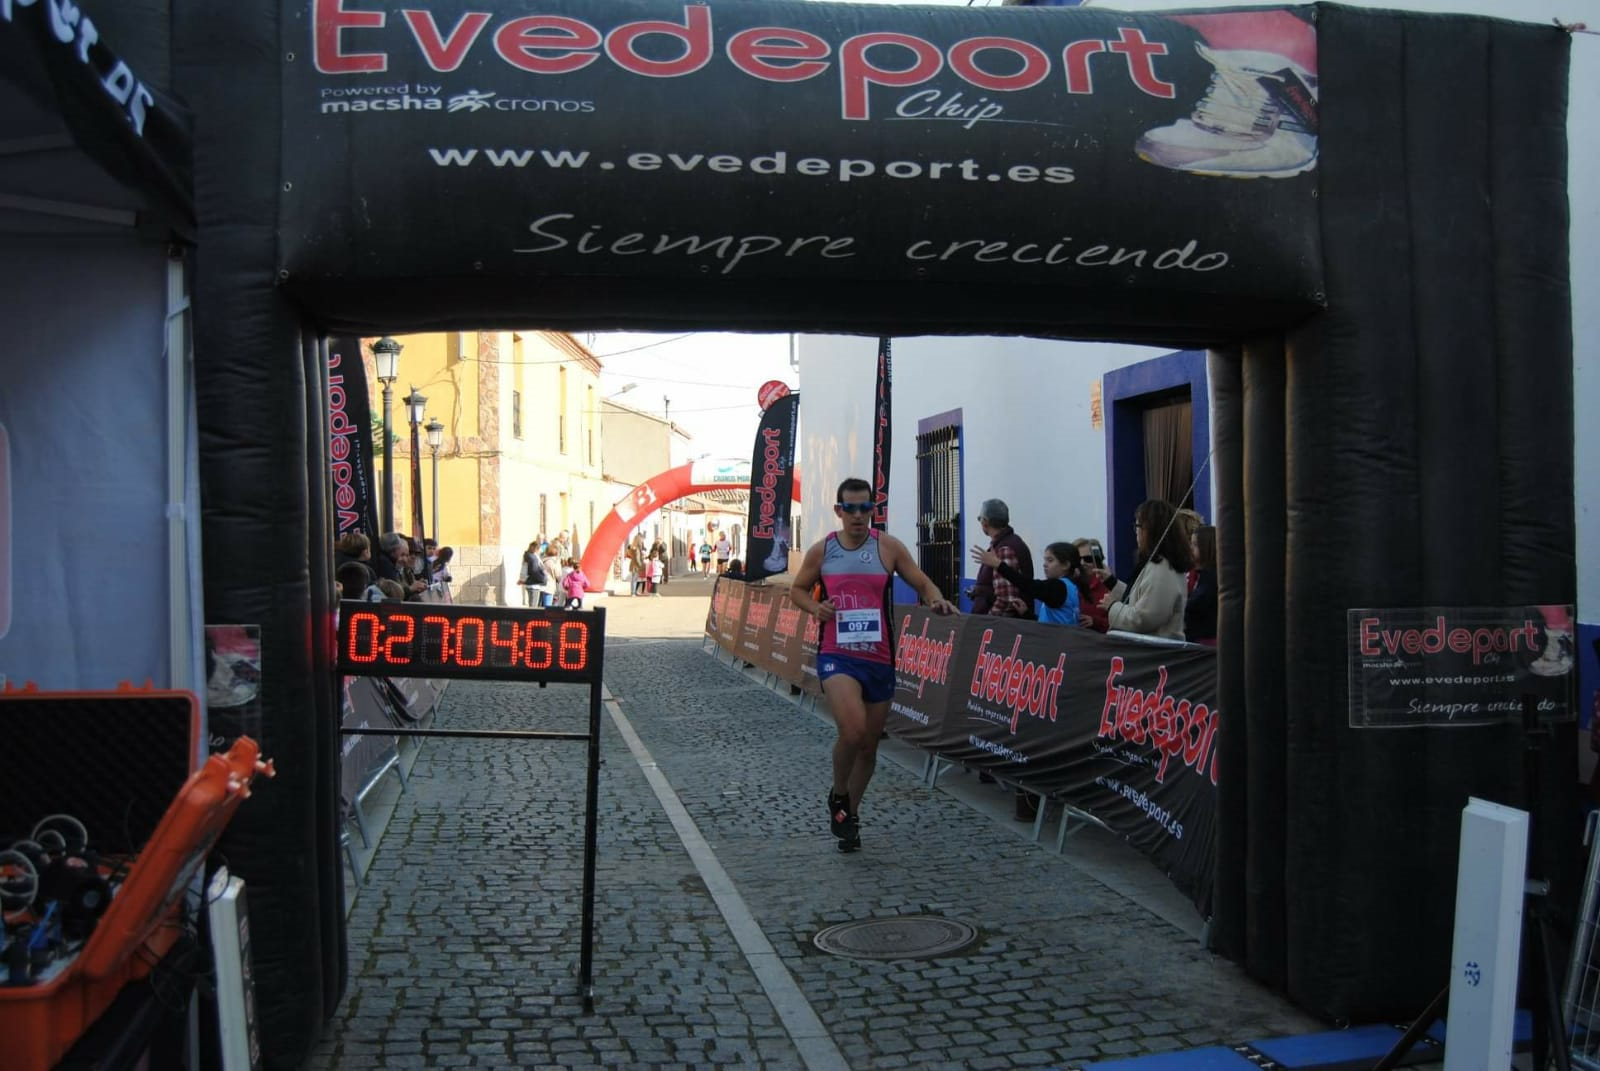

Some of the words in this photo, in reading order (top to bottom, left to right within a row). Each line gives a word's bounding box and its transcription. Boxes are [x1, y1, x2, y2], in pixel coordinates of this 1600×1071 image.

[312, 0, 1178, 121] Evedeport
[321, 84, 410, 98] Powered
[416, 83, 443, 96] by
[321, 95, 442, 114] macsha
[494, 97, 596, 113] cronos
[894, 88, 1005, 129] Chip
[427, 146, 1076, 184] www.evedeport.es
[512, 212, 858, 274] Siempre
[905, 235, 1230, 273] creciendo
[752, 427, 785, 539] Evedeport
[347, 612, 589, 671] 0:27:04:68
[847, 621, 870, 632] 097
[1360, 615, 1540, 665] Evedeport
[895, 614, 956, 699] Evedeport
[970, 628, 1067, 735] Evedeport
[1406, 698, 1480, 720] Siempre
[1487, 698, 1556, 713] creciedo
